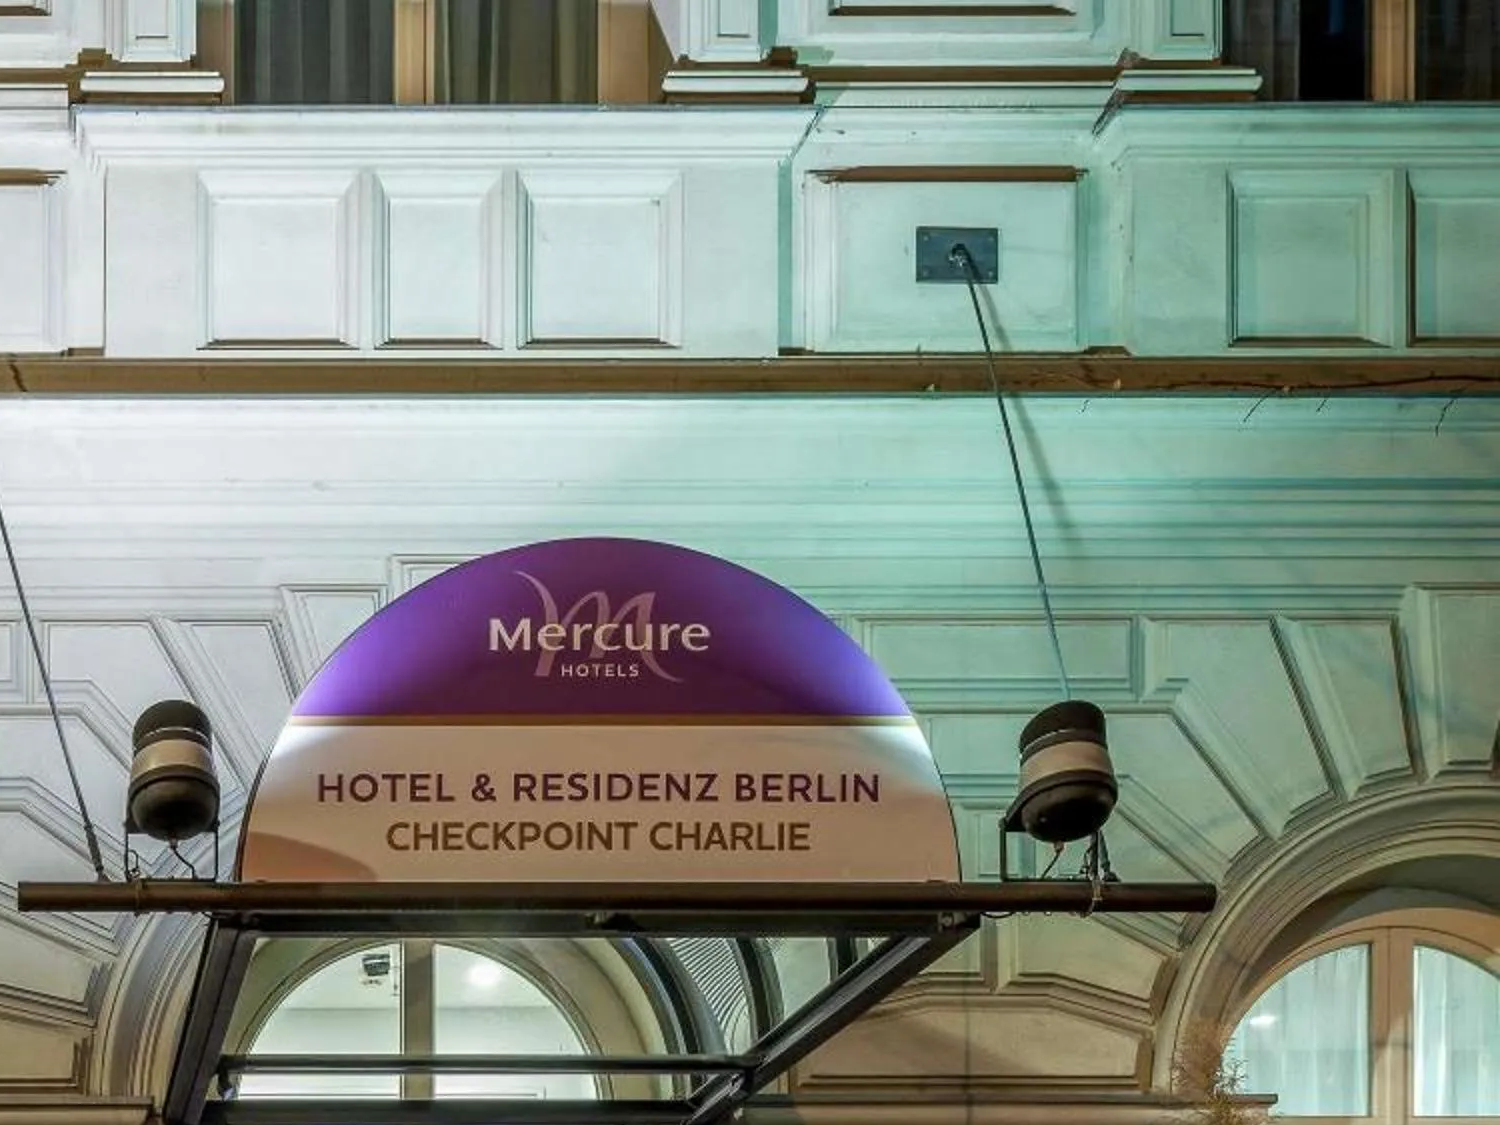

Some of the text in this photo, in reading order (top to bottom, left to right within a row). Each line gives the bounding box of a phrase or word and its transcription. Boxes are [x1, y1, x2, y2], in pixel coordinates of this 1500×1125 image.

[488, 616, 711, 652] Mercure
[560, 663, 640, 678] HOTELS
[317, 772, 880, 803] HOTEL & RESIDENZ BERLIN
[385, 820, 812, 852] CHECKPOINT CHARLIE
